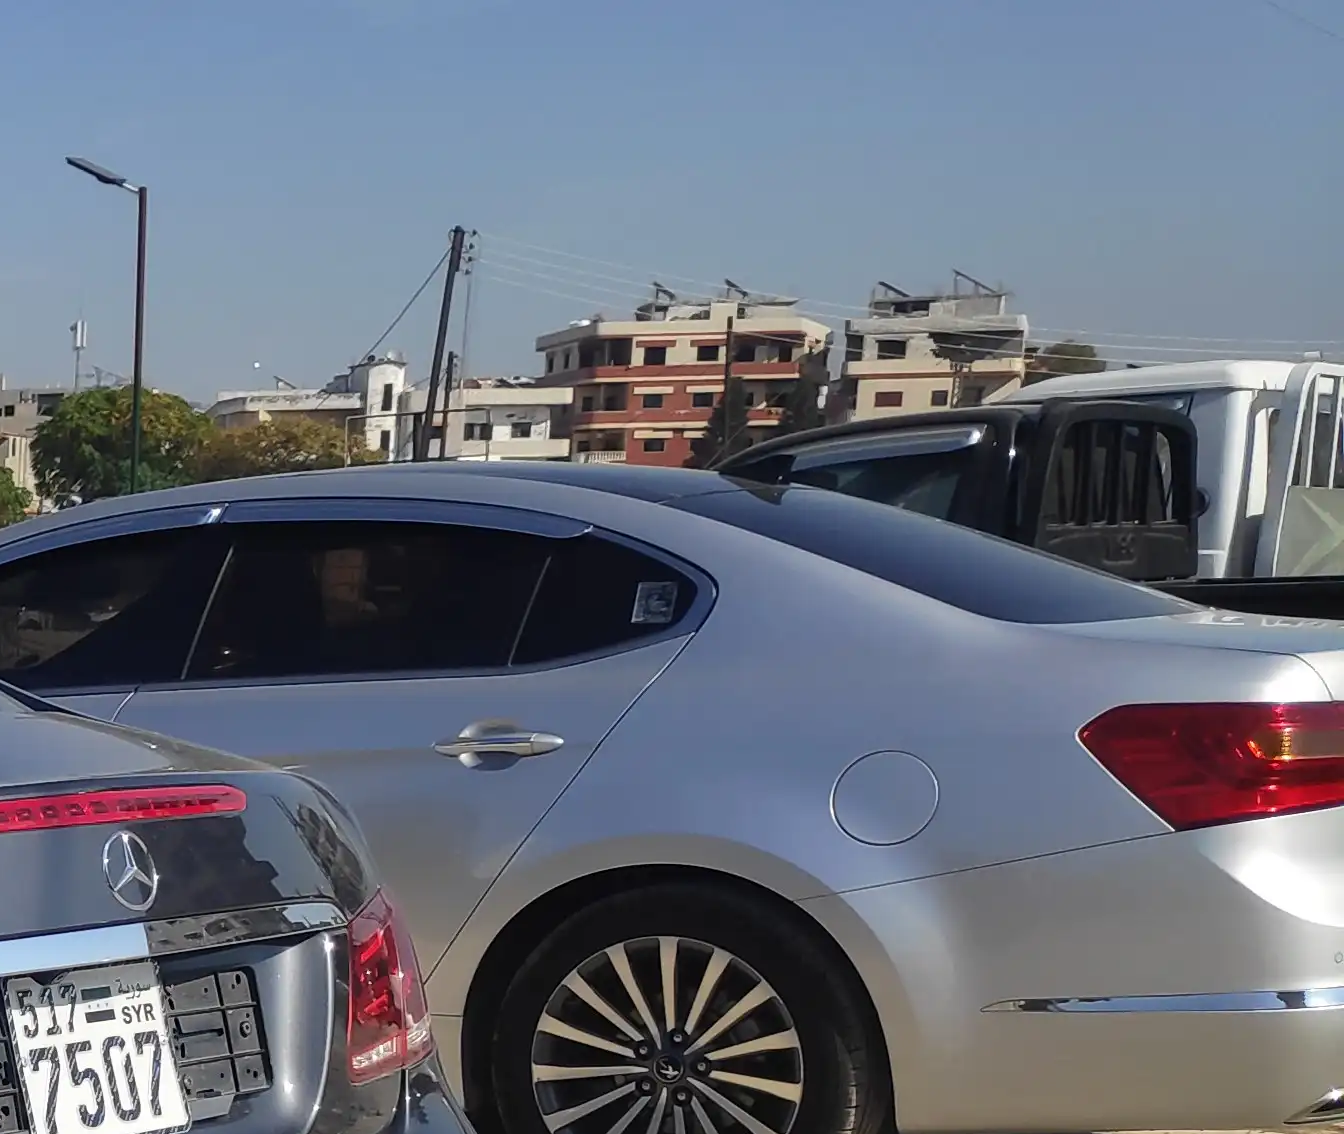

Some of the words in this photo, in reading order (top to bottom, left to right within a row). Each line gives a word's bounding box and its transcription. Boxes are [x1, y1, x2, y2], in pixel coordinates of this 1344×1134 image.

[114, 978, 152, 1000] سورية
[15, 982, 77, 1039] 517
[120, 1002, 157, 1025] SYR
